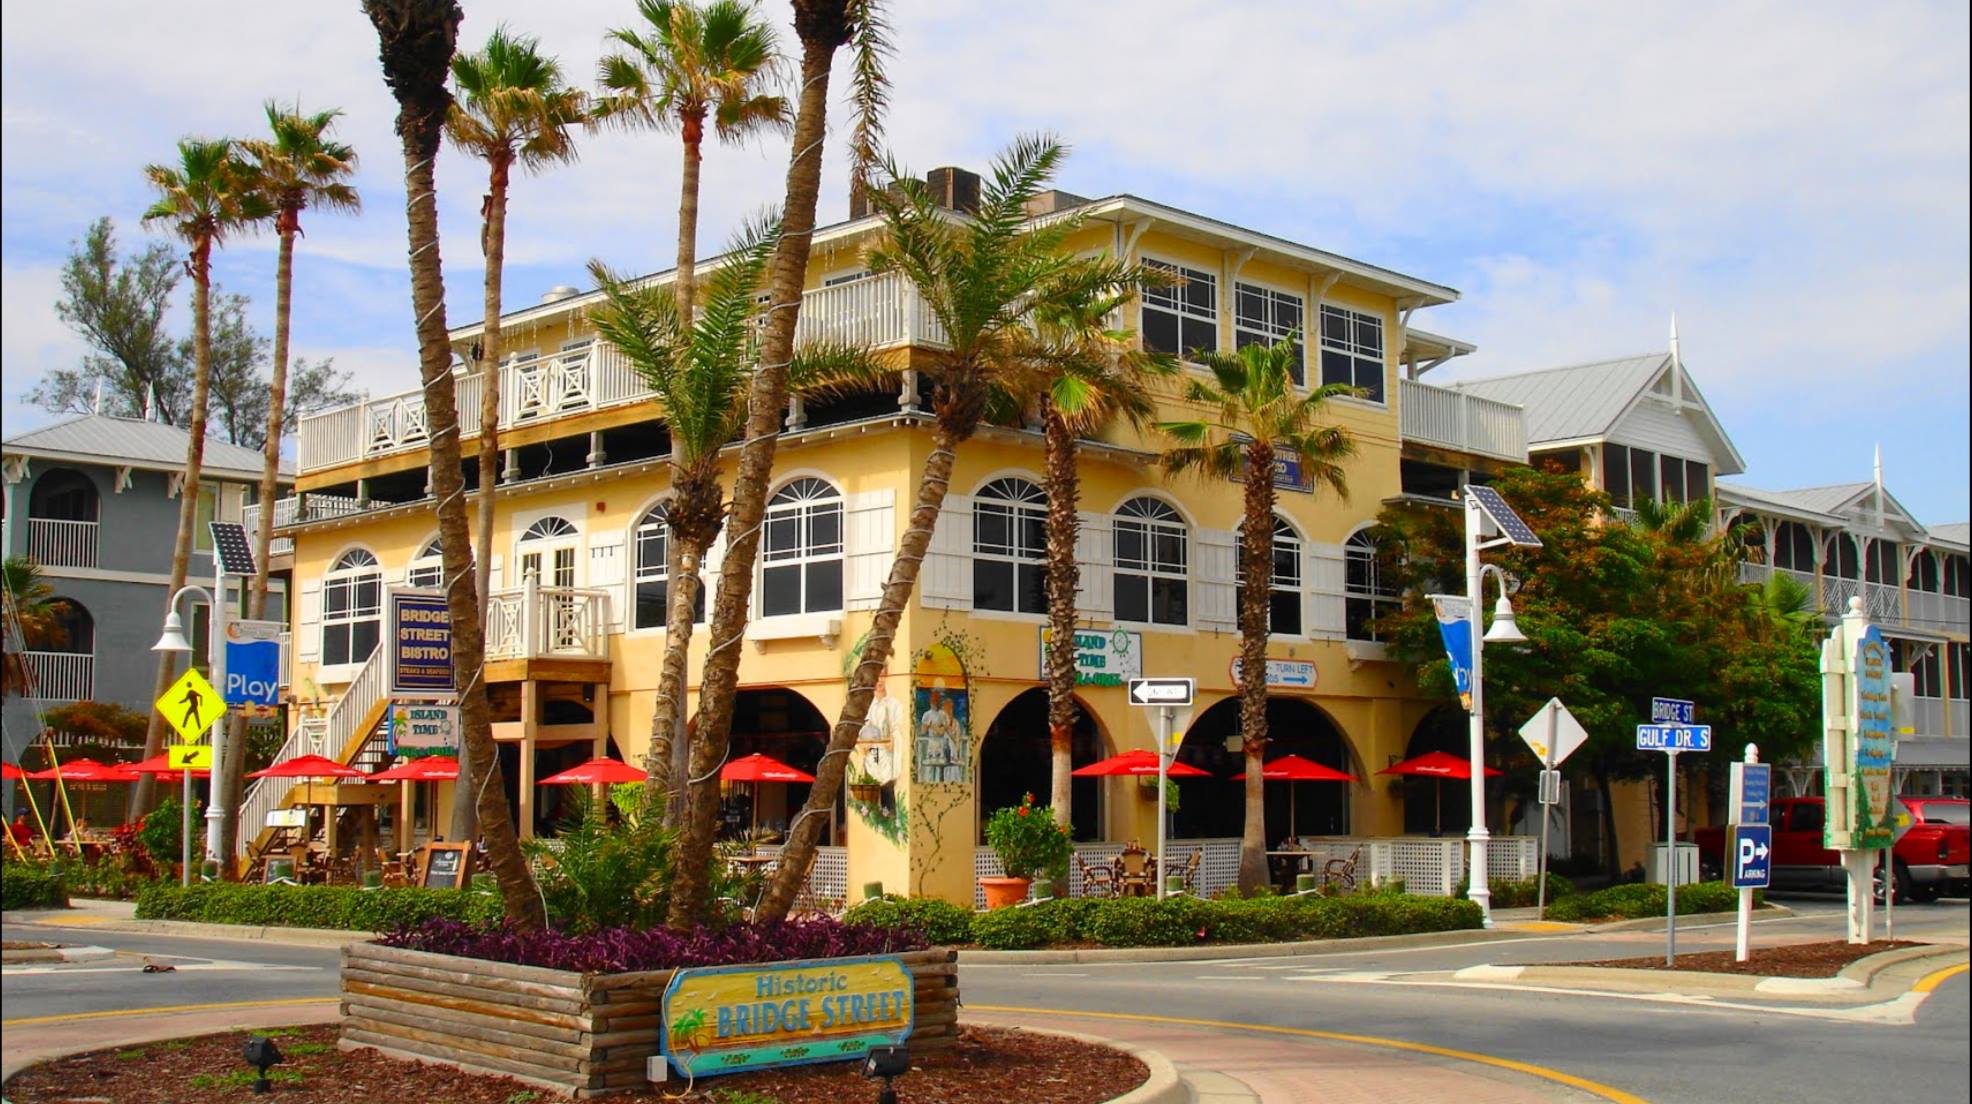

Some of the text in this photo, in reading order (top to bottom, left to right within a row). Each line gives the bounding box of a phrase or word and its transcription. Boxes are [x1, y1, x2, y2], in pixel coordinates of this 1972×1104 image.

[400, 608, 449, 623] BRIDGE
[400, 627, 449, 642] STREET
[401, 646, 449, 660] BISTRO
[227, 673, 277, 702] Play
[410, 709, 448, 720] ISLAND
[1654, 702, 1694, 722] BRIDGE ST
[412, 724, 439, 735] TIME
[1640, 728, 1709, 747] GULF DR. S
[756, 971, 848, 998] Historic
[716, 990, 904, 1038] BRIDGE STREET
